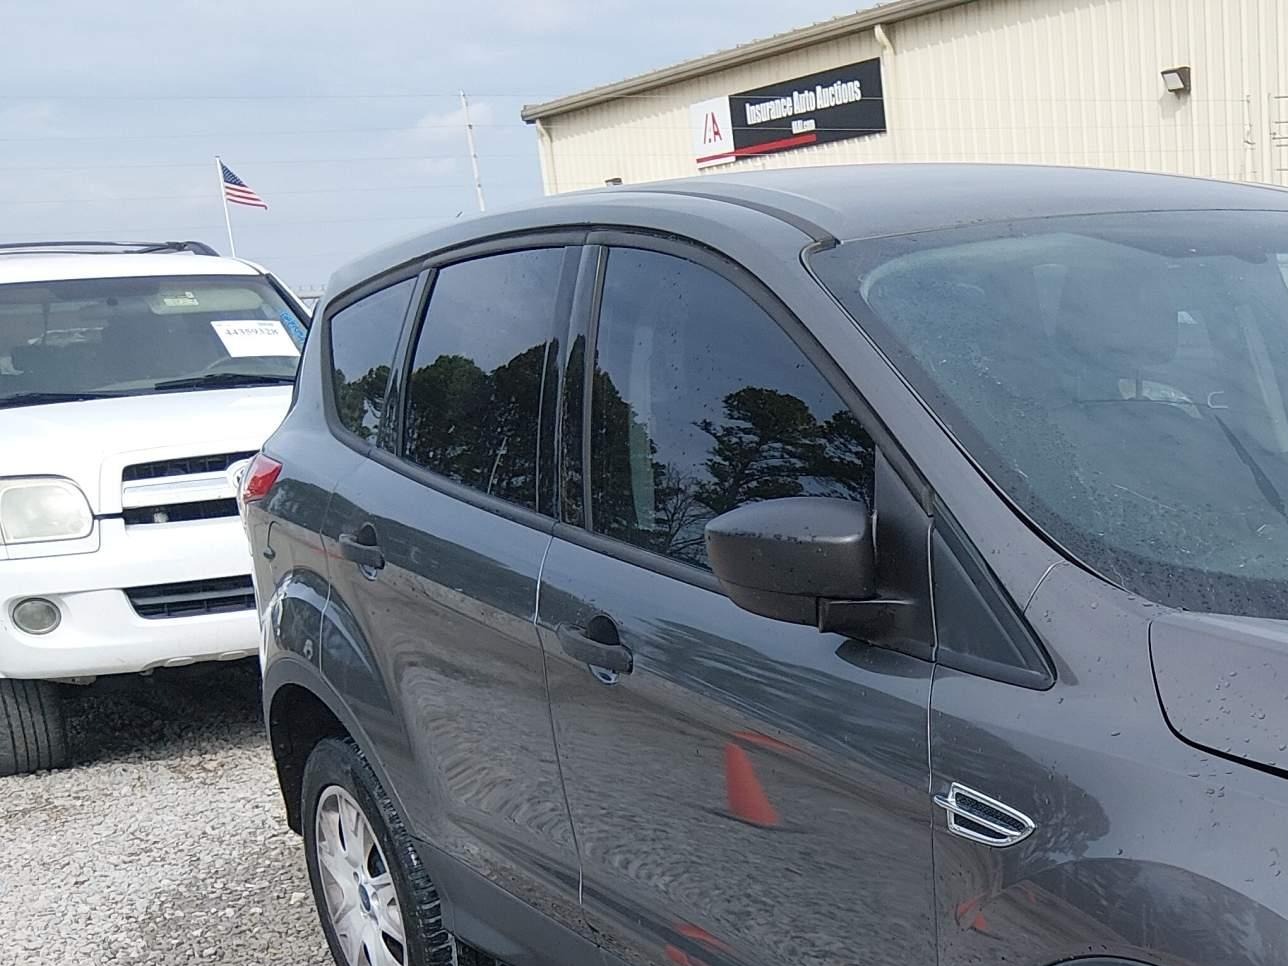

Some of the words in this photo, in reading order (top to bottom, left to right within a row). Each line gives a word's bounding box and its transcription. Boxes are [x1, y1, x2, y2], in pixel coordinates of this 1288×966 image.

[745, 96, 793, 125] Insurance
[792, 89, 816, 114] Auto
[815, 79, 862, 110] Auctions
